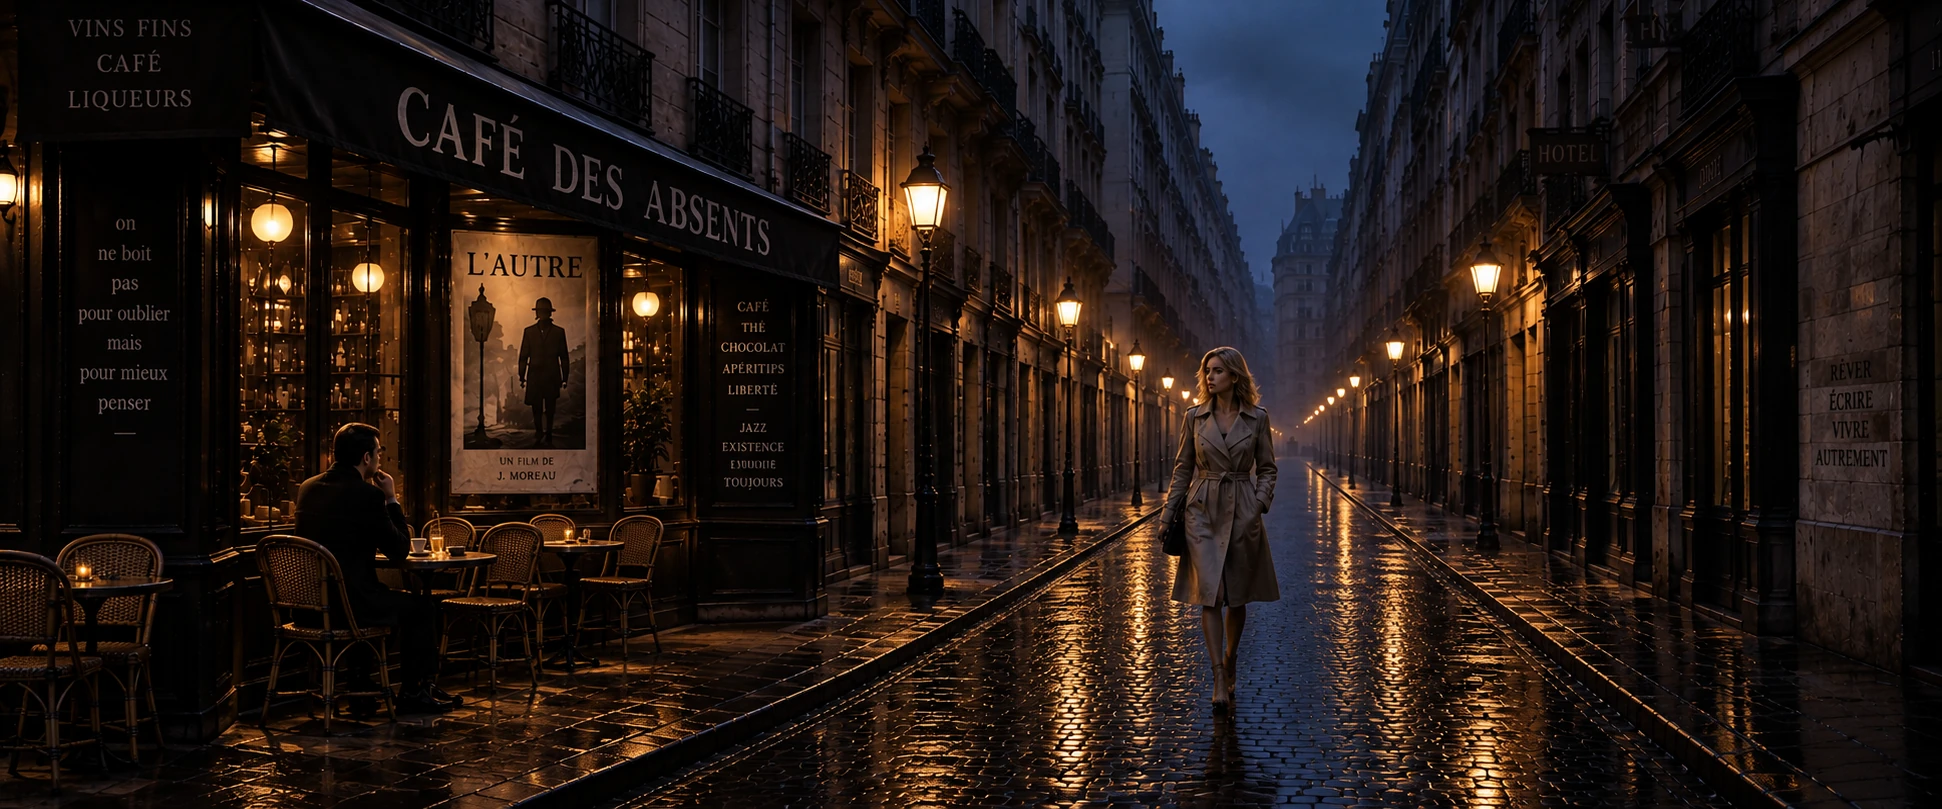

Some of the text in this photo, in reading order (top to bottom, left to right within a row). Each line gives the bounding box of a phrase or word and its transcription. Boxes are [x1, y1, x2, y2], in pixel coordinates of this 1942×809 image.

[68, 19, 191, 37] VINS FINS
[97, 50, 161, 72] CAFÉ
[69, 89, 191, 111] LIQUEURS
[1538, 144, 1599, 163] HOTEL
[397, 86, 771, 257] CAFÉ DES ABSENTS
[116, 219, 136, 230] on
[99, 245, 151, 261] ne boit
[112, 279, 138, 295] pas
[738, 299, 768, 312] CAFÉ
[79, 305, 170, 324] pour oublier
[741, 321, 765, 332] THÉ
[108, 334, 142, 350] mais
[720, 342, 786, 353] CHOCOLAT
[80, 364, 167, 384] pour mieux
[728, 383, 777, 395] LIBERTÉ
[99, 398, 151, 414] penser
[1830, 390, 1873, 410] ÉCRIRE
[740, 423, 766, 432] JAZZ
[1833, 421, 1869, 438] VIVRE
[723, 442, 784, 452] EXISTENCE
[499, 457, 554, 466] UN FILM DE
[1816, 450, 1887, 467] AUTREMENT
[497, 471, 556, 481] J. MOREAU
